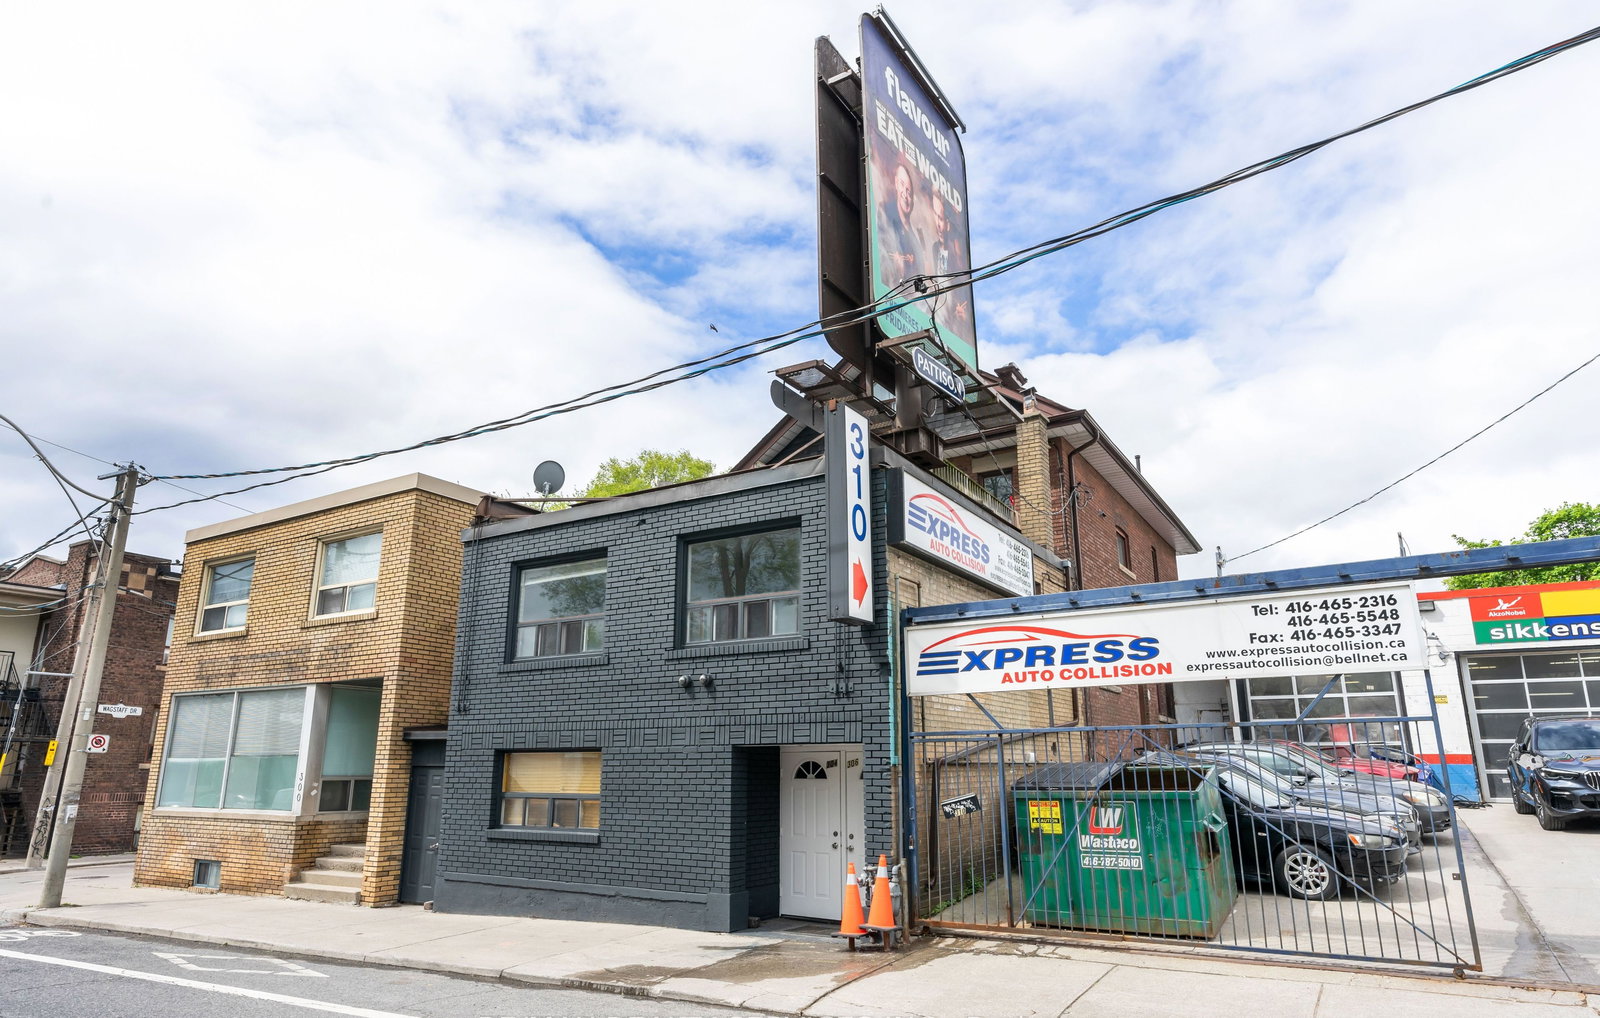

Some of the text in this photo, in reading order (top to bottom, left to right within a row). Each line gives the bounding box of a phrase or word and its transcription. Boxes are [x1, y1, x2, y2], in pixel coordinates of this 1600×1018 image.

[885, 66, 950, 157] flavour
[876, 107, 904, 153] EAT
[916, 148, 962, 213] WORLD
[917, 352, 962, 397] PATTISON
[850, 422, 867, 541] 310
[908, 501, 990, 564] EXPRESS
[930, 539, 986, 575] AUTO COLLISION
[1251, 594, 1398, 616] Tel: 416-465-2316
[1488, 609, 1526, 617] AkzoNobel
[1287, 608, 1400, 628] 416-465-5548
[1249, 623, 1402, 644] Fax: 416-465-3347
[1490, 622, 1600, 640] sikkens
[916, 637, 1160, 677] EXPRESS
[1206, 638, 1406, 659] www.expressautocollision.ca
[1186, 652, 1408, 671] expressautocollision@bellnet.ca
[1001, 662, 1172, 684] AUTO COLLISION
[847, 758, 859, 768] 306
[1081, 835, 1138, 850] Wasteco
